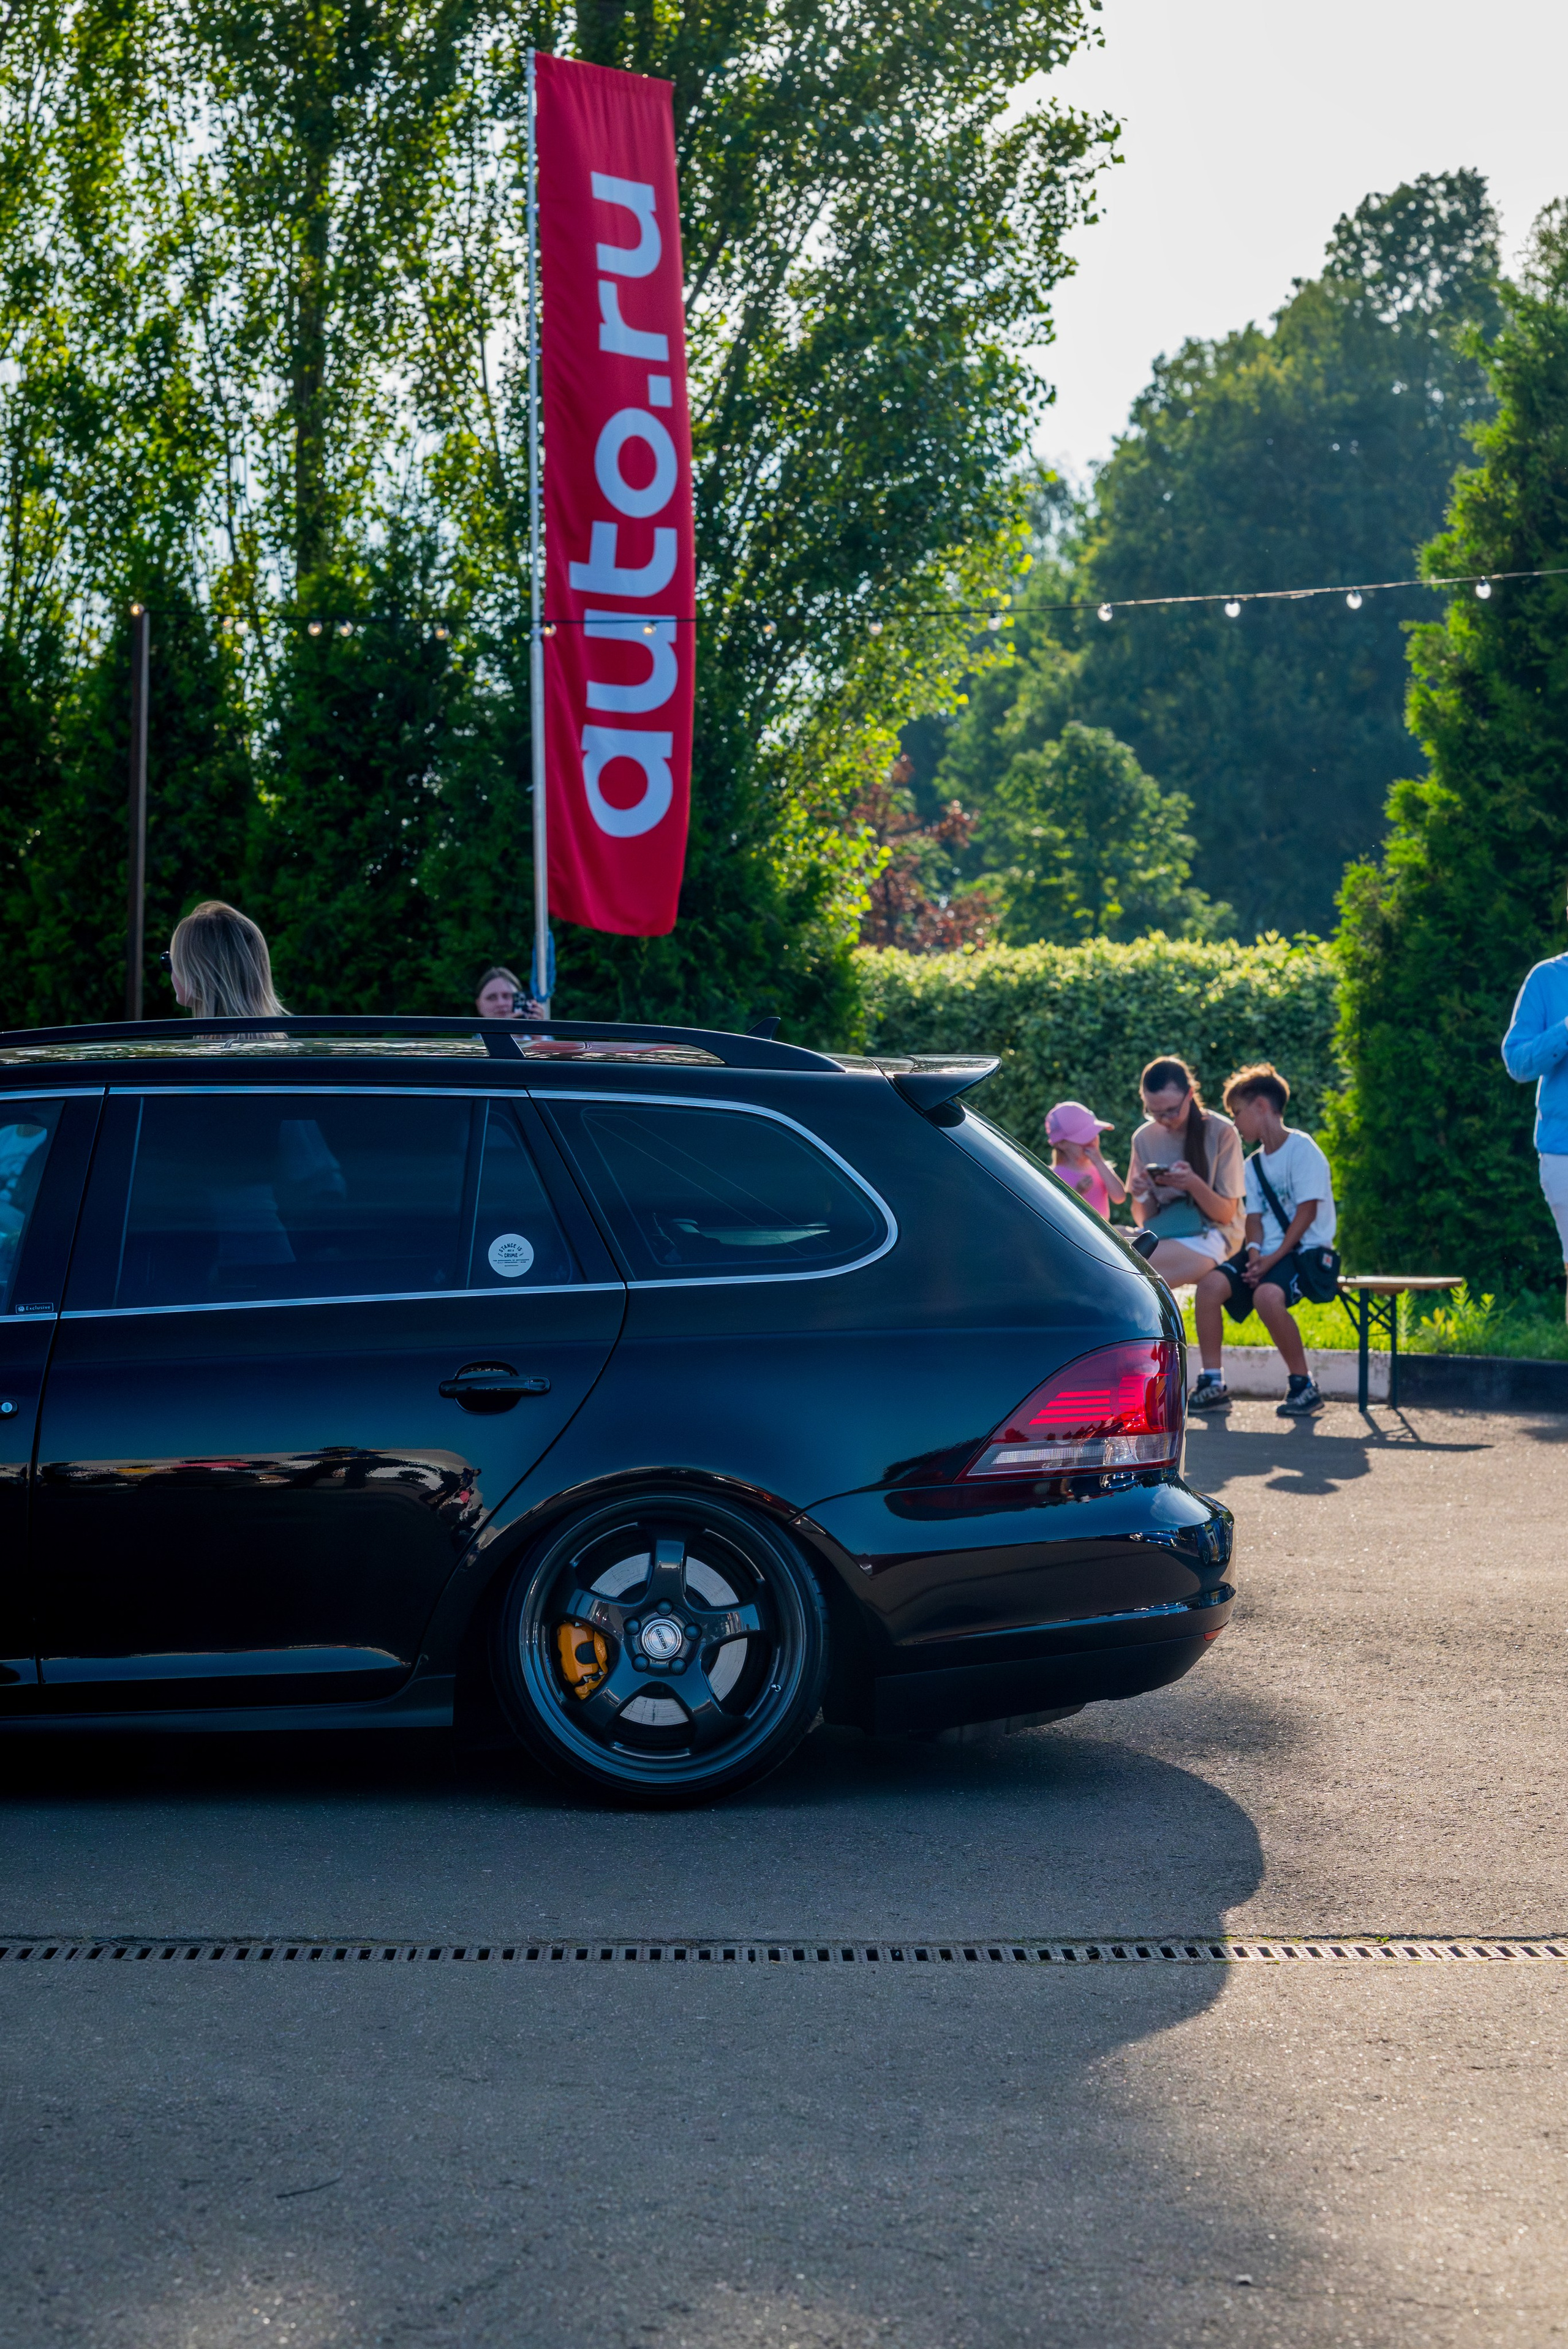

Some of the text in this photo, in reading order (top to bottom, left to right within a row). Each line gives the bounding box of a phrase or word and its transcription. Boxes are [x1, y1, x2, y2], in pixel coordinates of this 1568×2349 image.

[568, 171, 678, 837] auto.ru
[499, 1243, 517, 1253] STANCE
[656, 1628, 668, 1650] MEISTER
